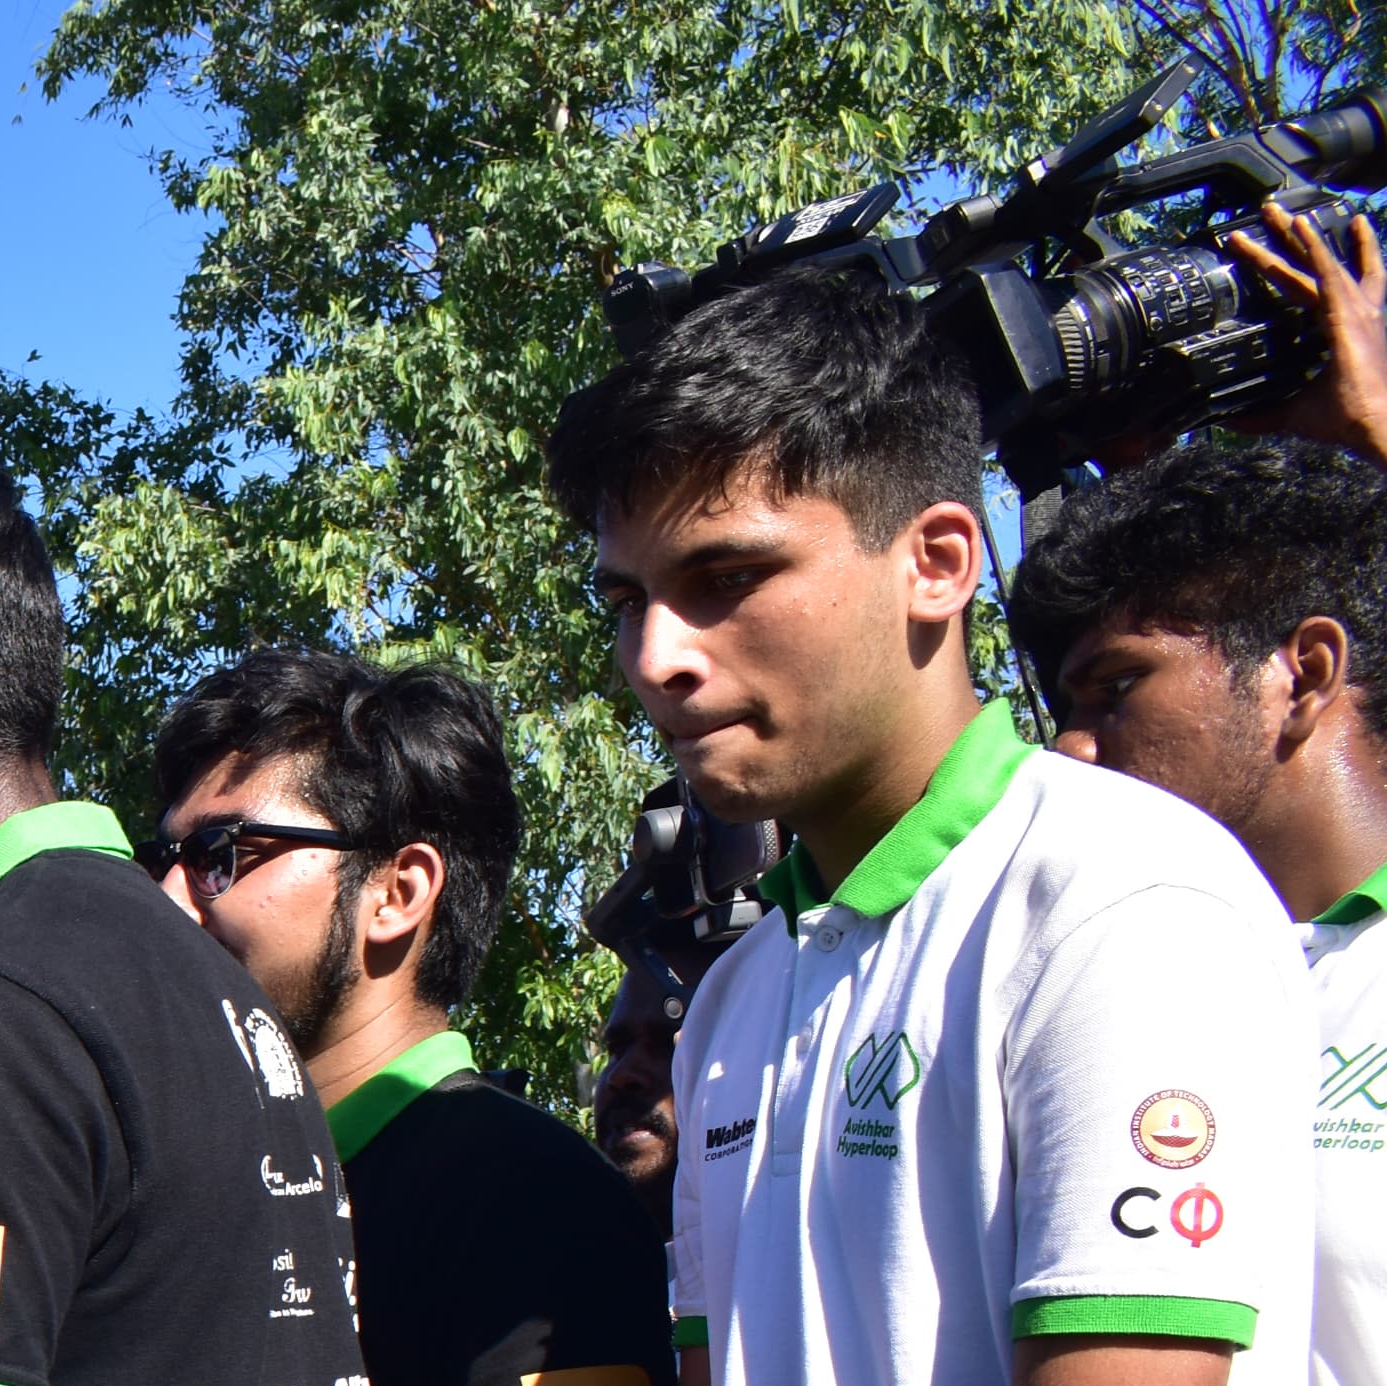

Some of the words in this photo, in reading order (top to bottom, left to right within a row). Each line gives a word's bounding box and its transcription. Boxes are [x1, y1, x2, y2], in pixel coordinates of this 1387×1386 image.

[611, 281, 634, 297] SONY
[843, 1117, 895, 1138] Avishkar
[836, 1135, 898, 1160] Hyperloop
